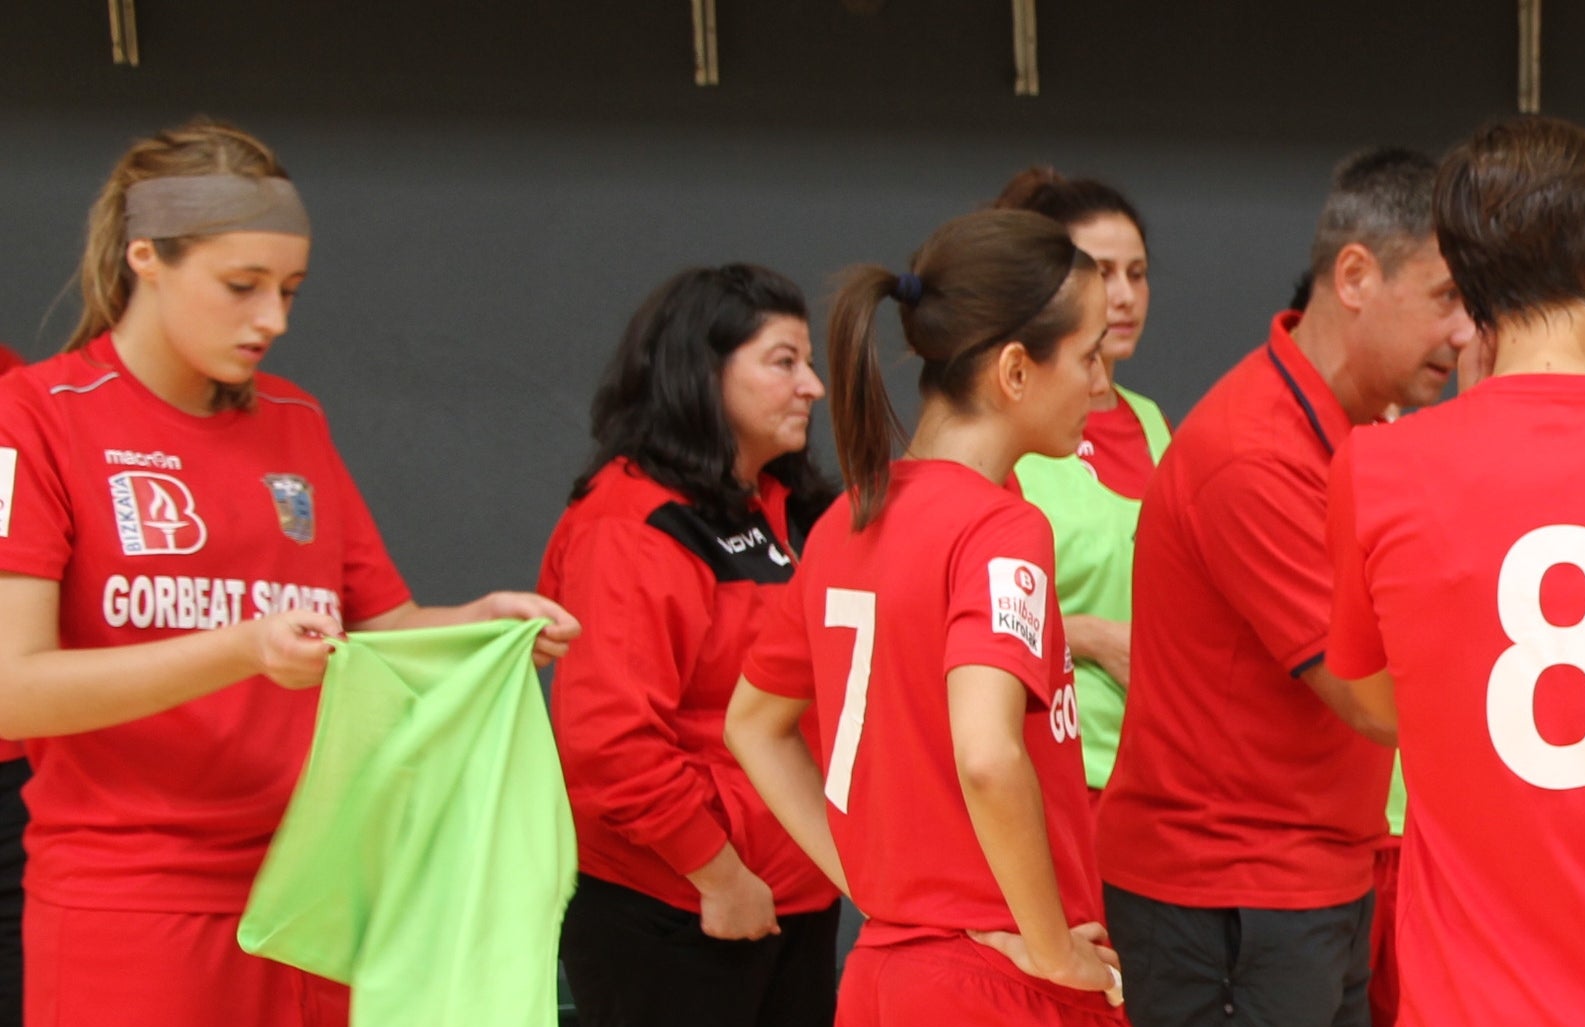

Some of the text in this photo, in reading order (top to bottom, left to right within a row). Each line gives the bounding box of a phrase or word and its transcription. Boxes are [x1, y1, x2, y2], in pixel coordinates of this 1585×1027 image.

[104, 449, 182, 470] macron
[115, 476, 143, 552] BIZKAIA
[103, 574, 245, 630] GORBEAT
[998, 597, 1040, 632] Bilbao
[999, 612, 1038, 652] Kirolak
[824, 587, 876, 815] 7
